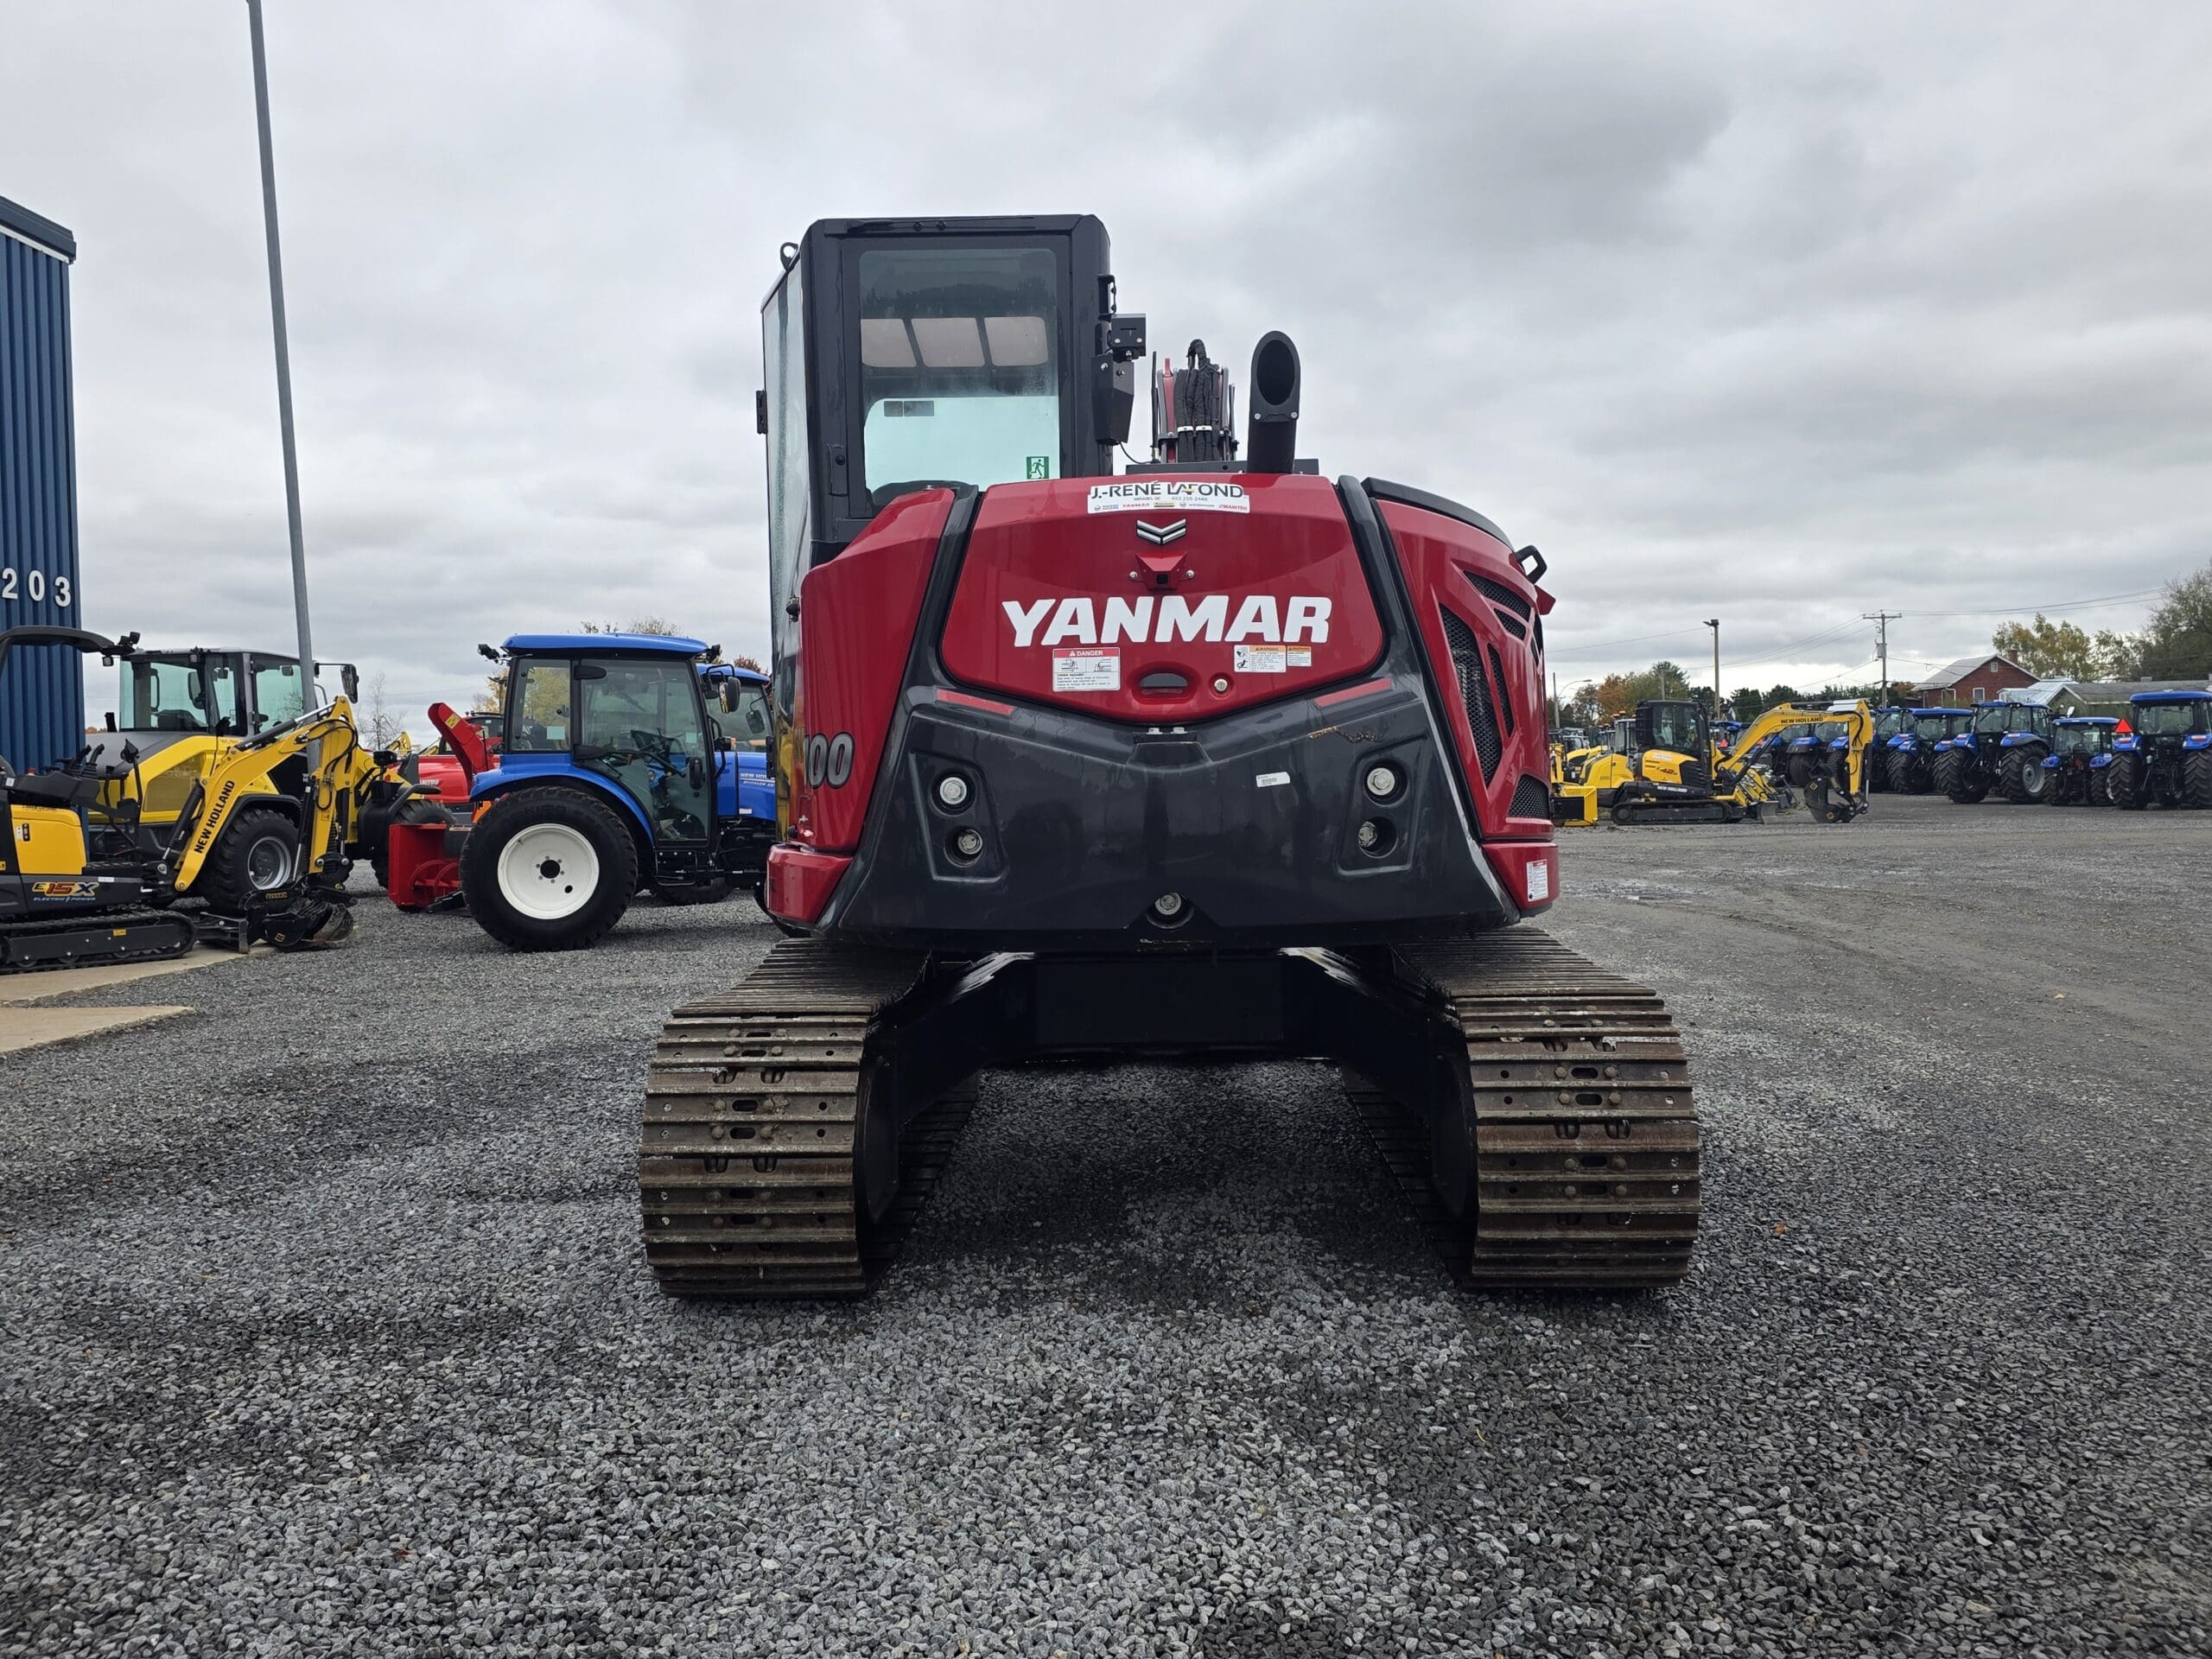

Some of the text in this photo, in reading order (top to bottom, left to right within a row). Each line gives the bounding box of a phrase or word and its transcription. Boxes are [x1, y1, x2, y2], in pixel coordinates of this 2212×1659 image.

[1092, 480, 1243, 499] J.-RENÉ LAFOND
[2, 567, 71, 607] 203
[1001, 594, 1332, 647] YANMAR
[194, 780, 235, 854] NEW HOLLAND
